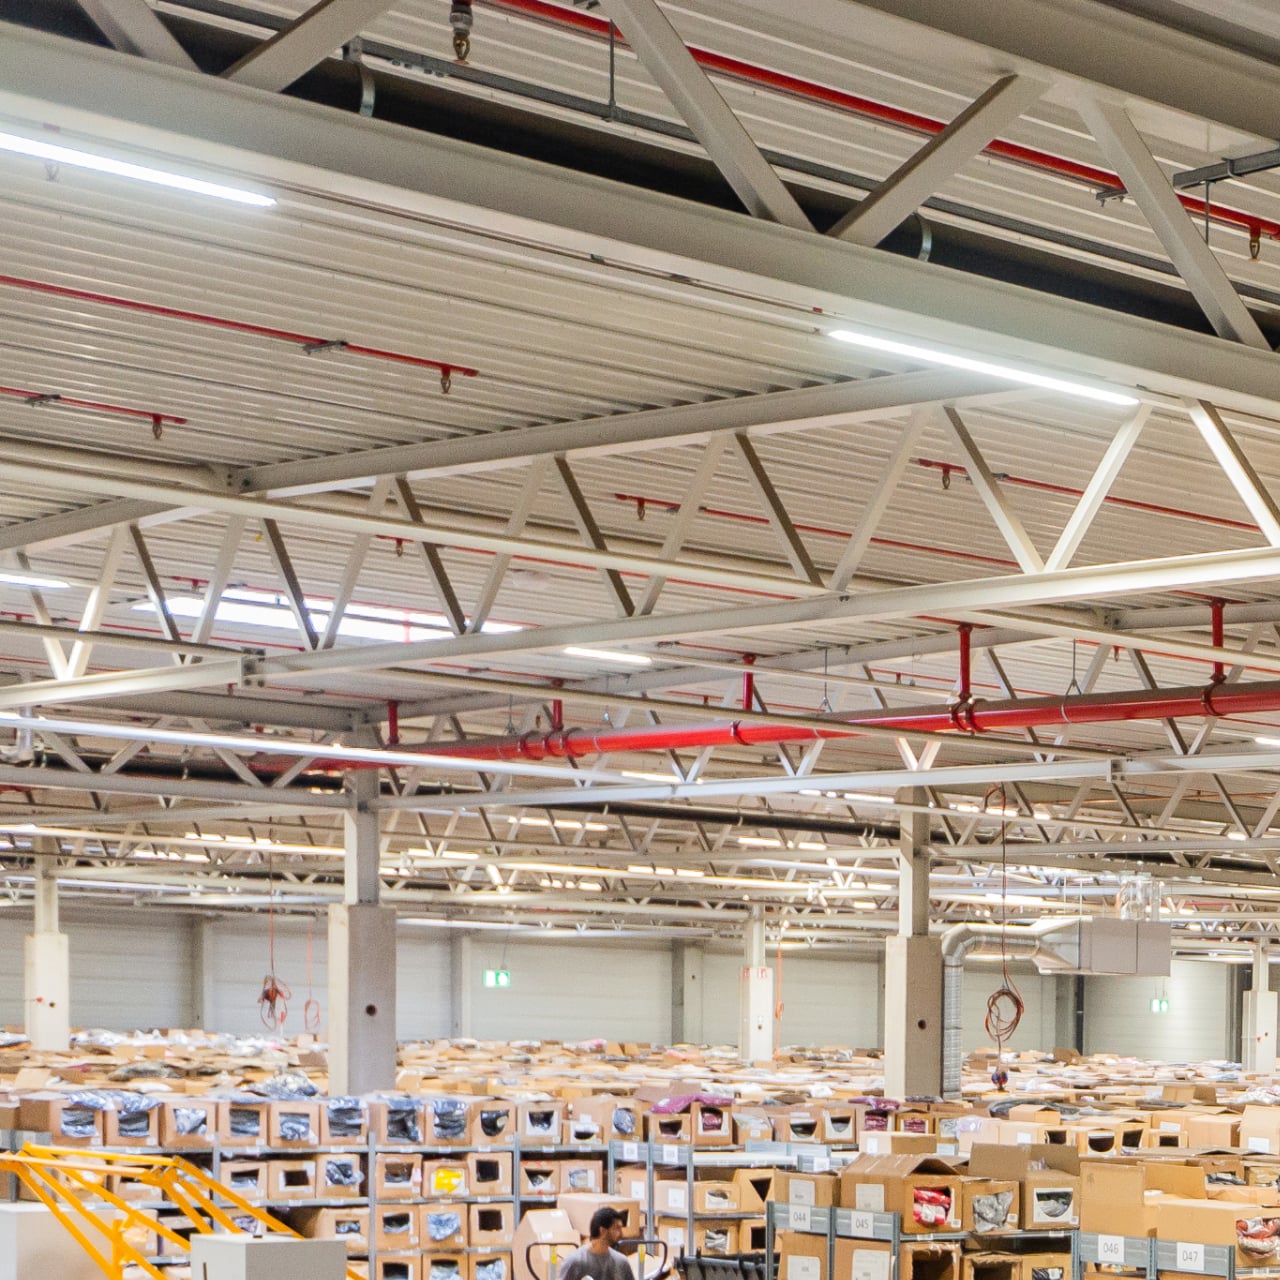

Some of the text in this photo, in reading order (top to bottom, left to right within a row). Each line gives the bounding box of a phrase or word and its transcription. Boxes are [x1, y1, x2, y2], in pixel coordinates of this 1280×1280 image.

[855, 1218, 869, 1229] 045
[1103, 1242, 1119, 1254] 046
[1182, 1250, 1198, 1263] 047
